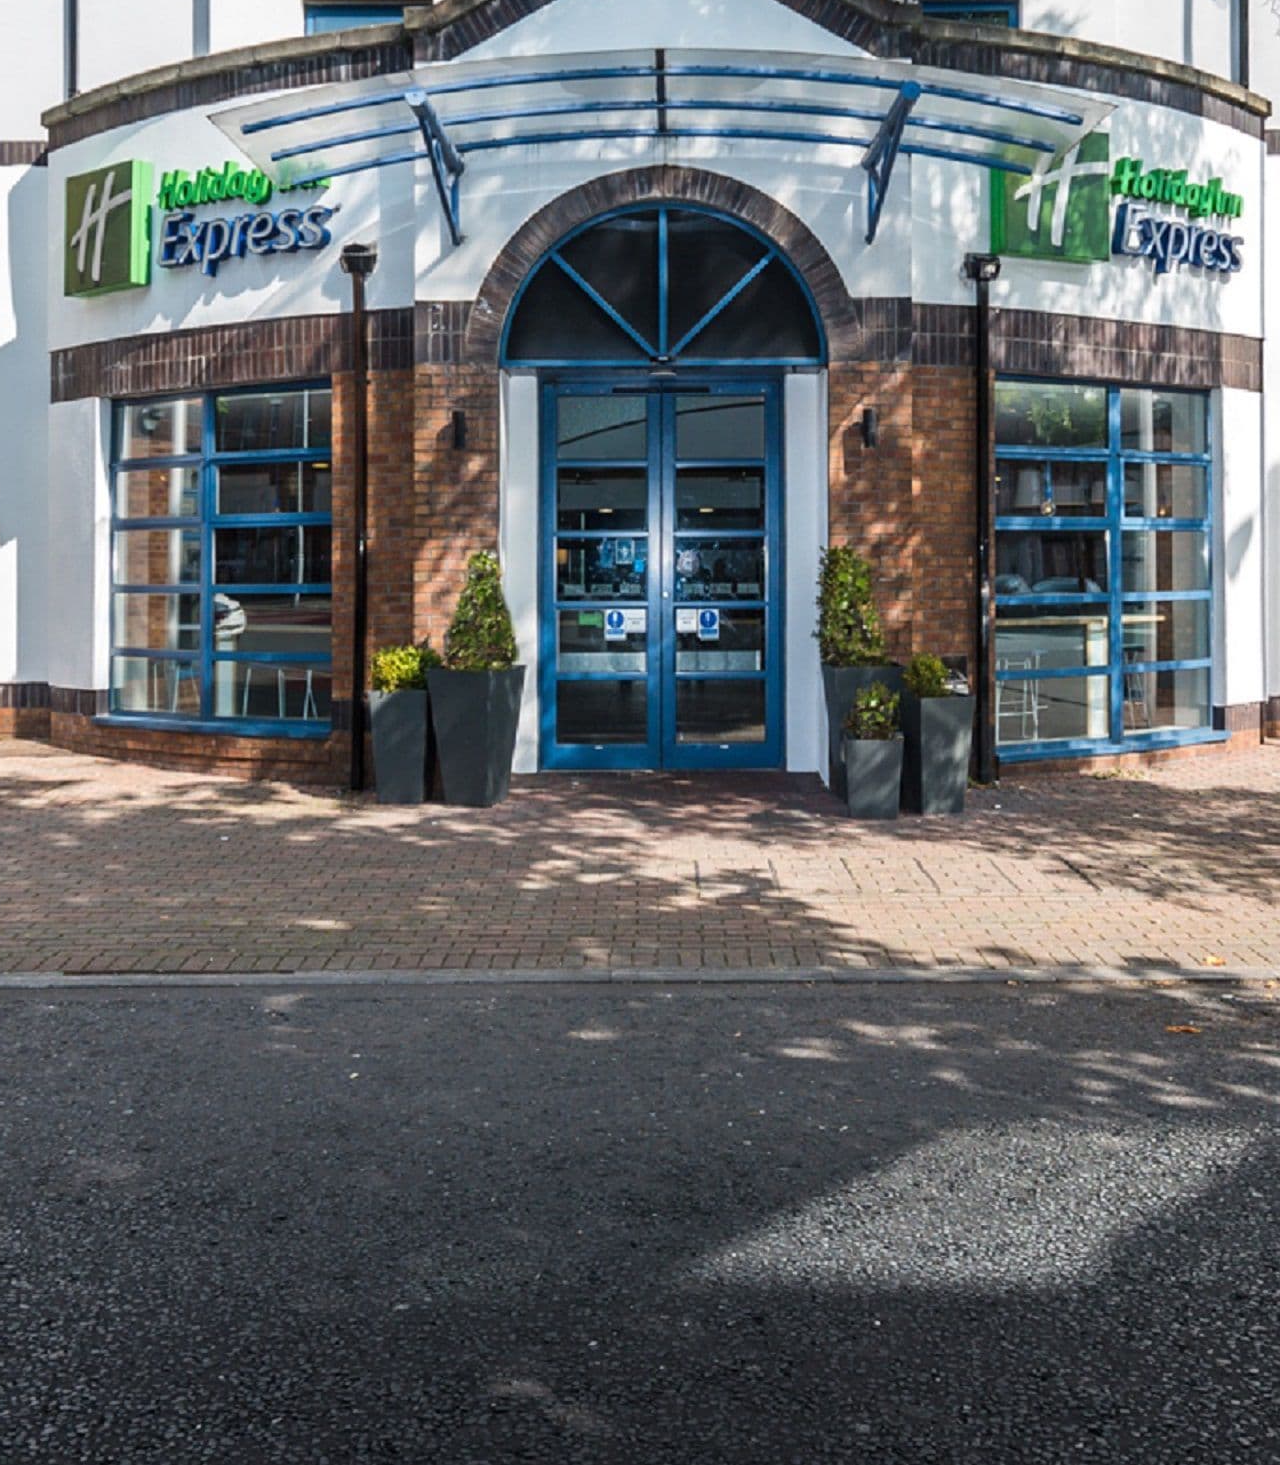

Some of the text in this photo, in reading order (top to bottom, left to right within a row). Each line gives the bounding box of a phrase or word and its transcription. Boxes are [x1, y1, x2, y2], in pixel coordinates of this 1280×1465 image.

[158, 162, 272, 210] Holiday
[1111, 157, 1244, 218] Holiday Inn
[71, 171, 131, 282] H
[158, 205, 334, 276] Express
[1112, 203, 1245, 274] Express
